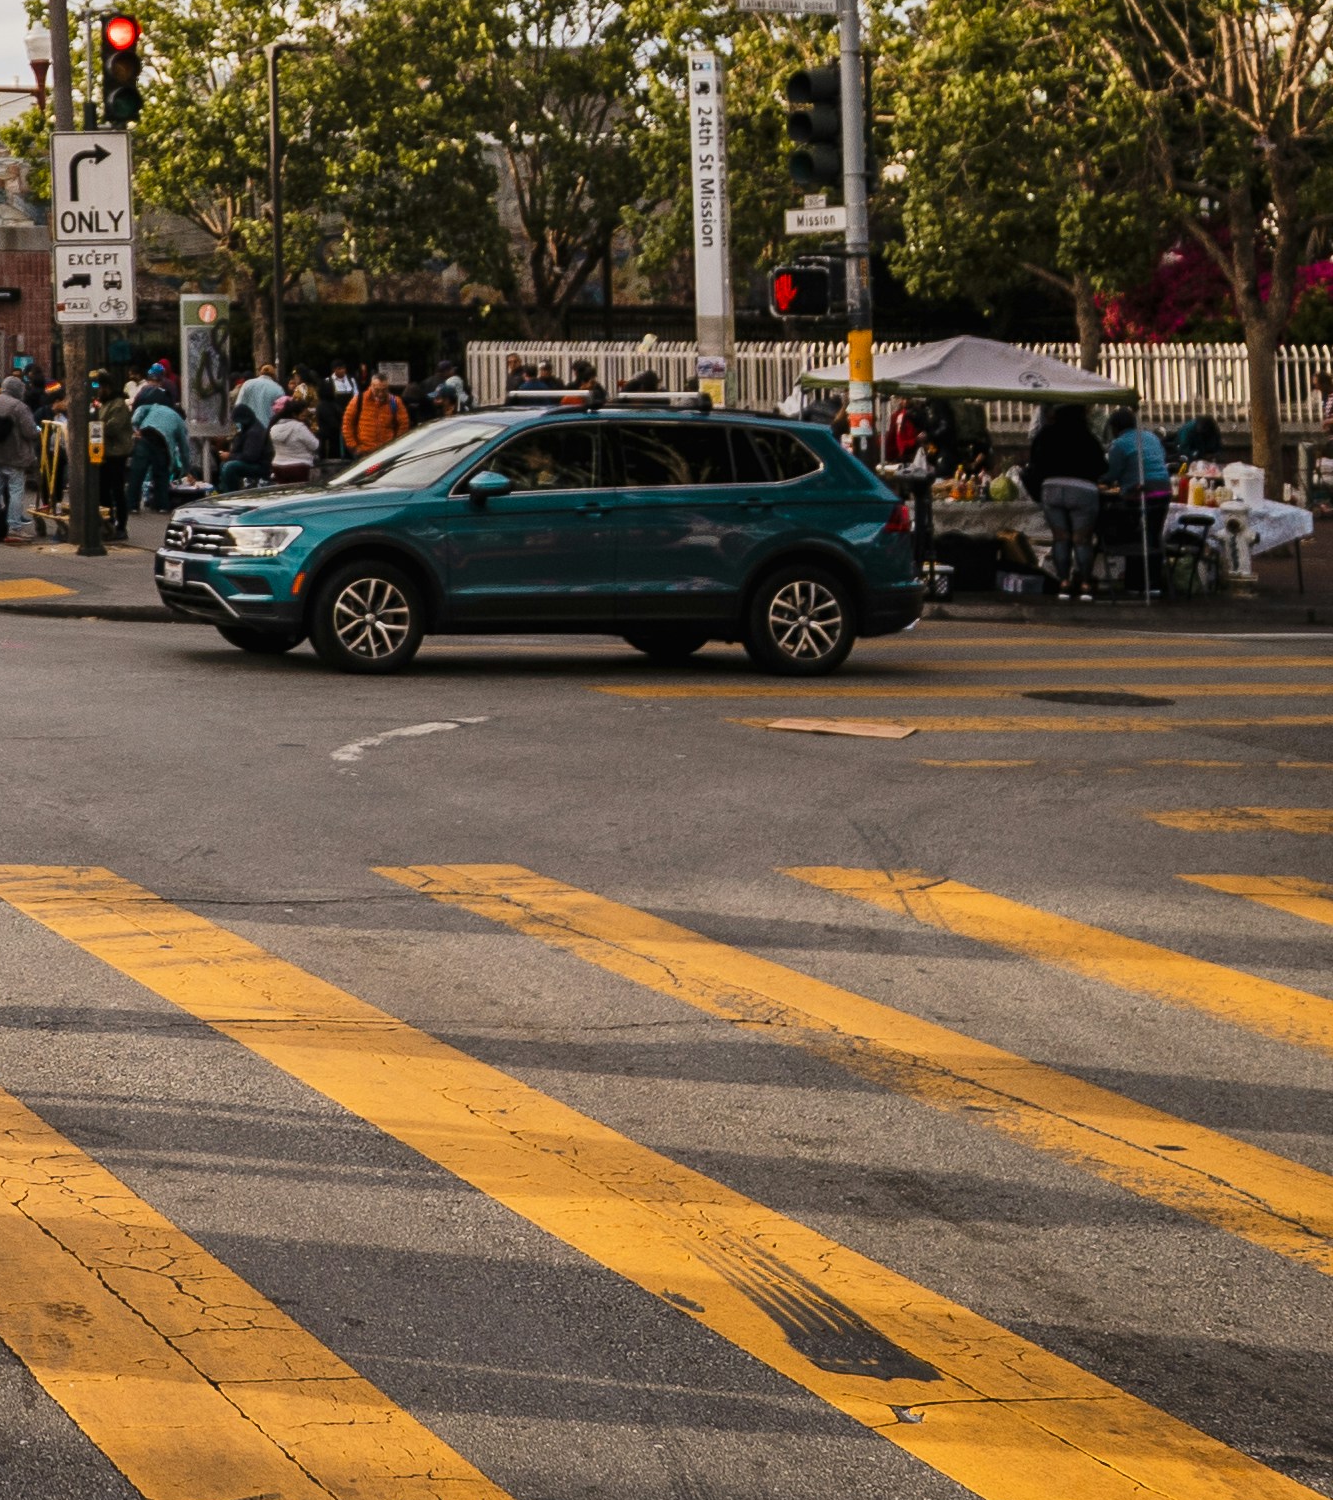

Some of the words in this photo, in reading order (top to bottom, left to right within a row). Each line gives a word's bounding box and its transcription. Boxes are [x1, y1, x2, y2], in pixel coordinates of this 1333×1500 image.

[697, 106, 713, 147] 24th
[699, 153, 715, 171] St
[60, 209, 124, 234] ONLY
[700, 178, 717, 248] Mission
[796, 213, 836, 227] Mission
[68, 252, 119, 267] EXCEPT
